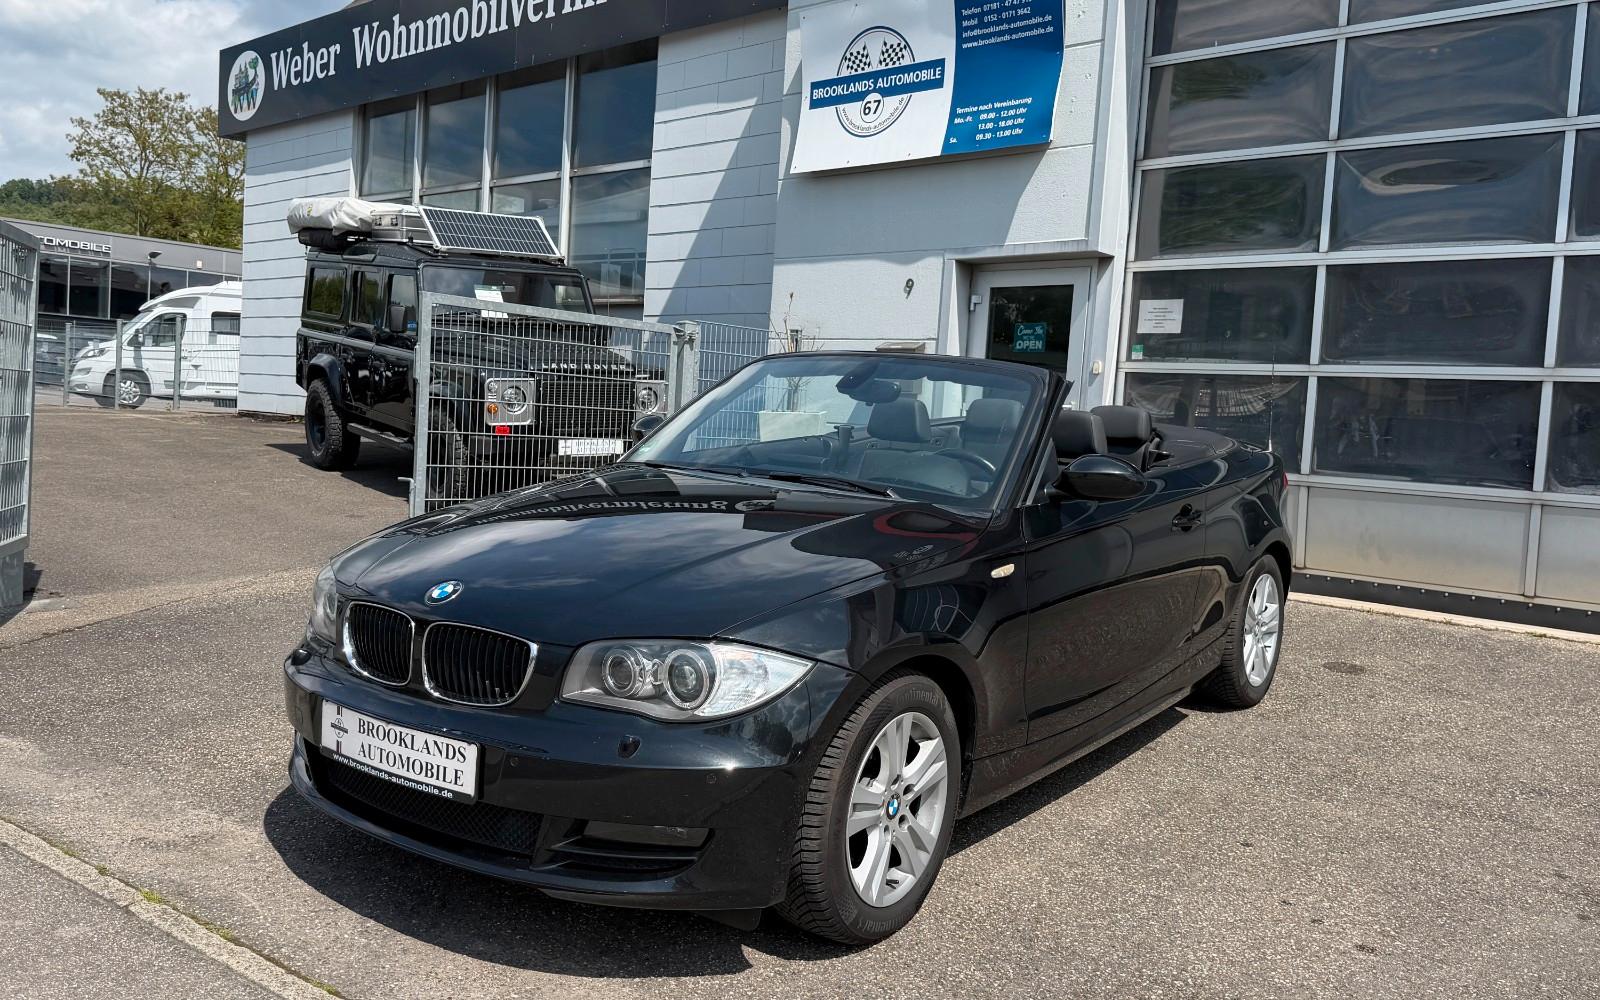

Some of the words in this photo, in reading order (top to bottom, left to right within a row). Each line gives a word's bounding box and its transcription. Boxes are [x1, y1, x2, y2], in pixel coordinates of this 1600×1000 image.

[961, 7, 982, 16] Telefon
[983, 2, 1000, 11] 07181
[962, 17, 978, 27] Mobil
[983, 14, 998, 22] 0152
[1002, 10, 1016, 19] 0171
[961, 25, 1054, 48] www.brooklands-automobile.de
[962, 14, 1053, 38] info@brooklands-automobile.de
[270, 40, 341, 91] Weber
[812, 79, 874, 100] BROOKLANDS
[876, 67, 942, 88] AUTOMOBILE
[862, 99, 882, 116] 67
[956, 105, 978, 114] Termine
[978, 102, 993, 111] nach
[993, 97, 1033, 109] Vereinbarung
[979, 112, 996, 120] 09.00
[1000, 109, 1016, 117] 12.00
[1016, 107, 1028, 115] Uhr
[905, 278, 915, 300] 9
[1016, 340, 1043, 350] OPEN
[358, 717, 467, 763] BROOKLANDS
[357, 741, 464, 787] AUTOMOBILE
[332, 753, 453, 799] www.brooklands-automobile.de
